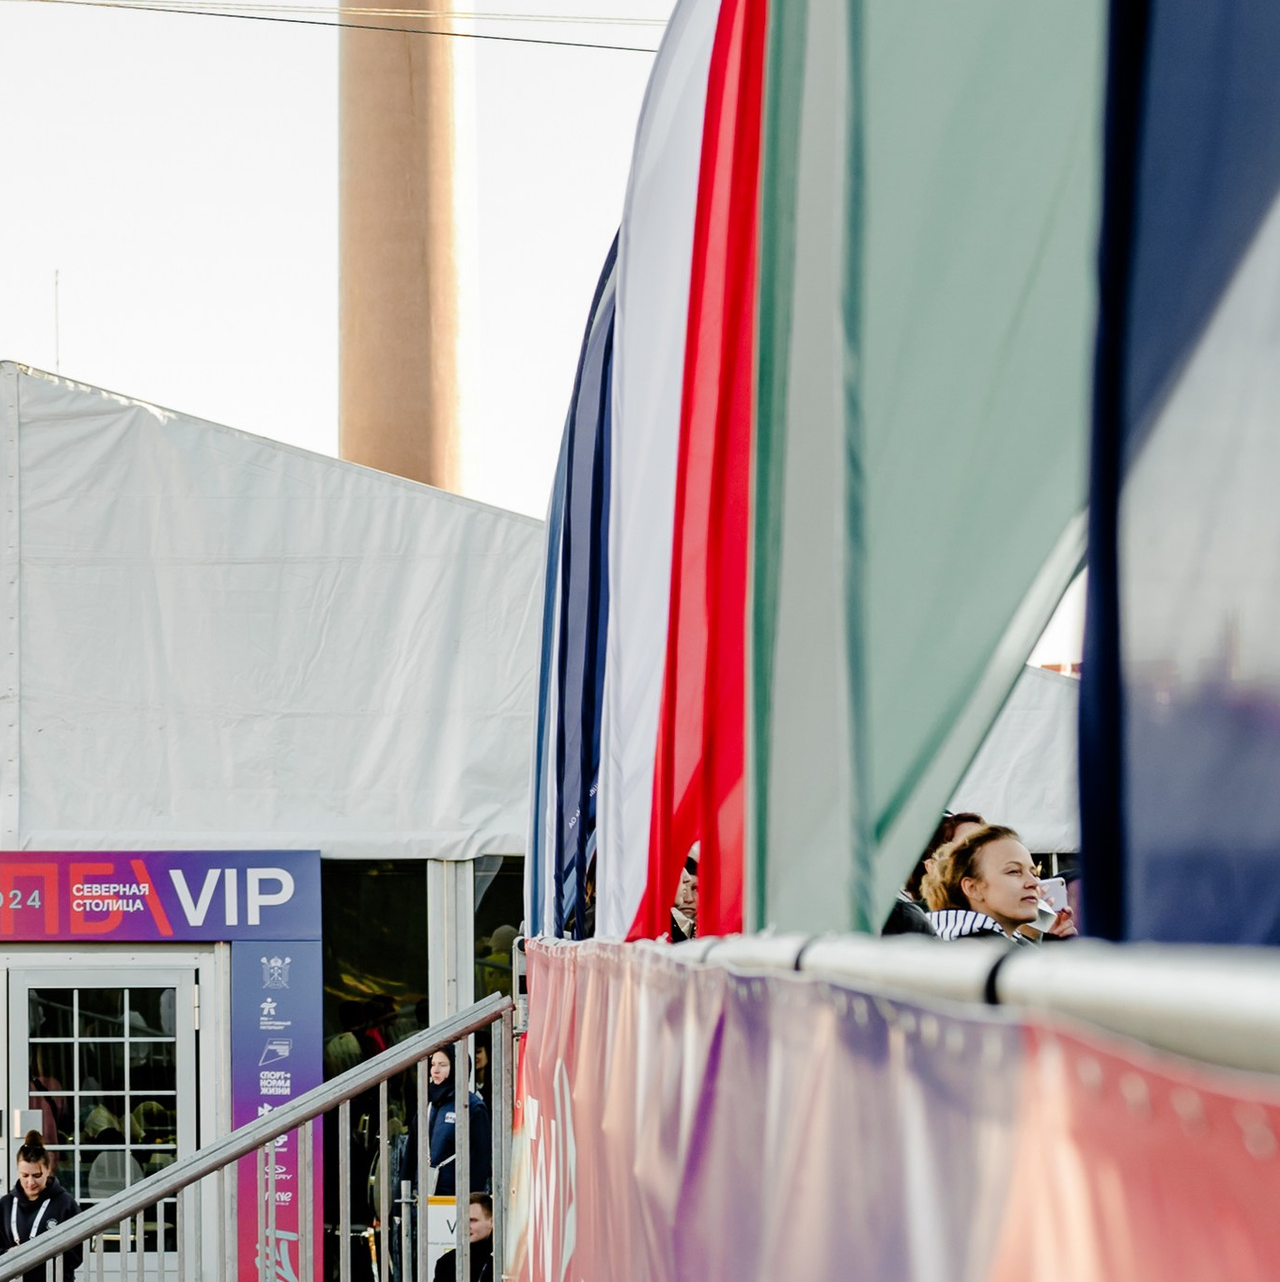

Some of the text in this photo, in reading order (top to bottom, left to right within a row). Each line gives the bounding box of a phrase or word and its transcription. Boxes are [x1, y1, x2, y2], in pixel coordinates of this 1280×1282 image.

[72, 883, 149, 896] СЕВЕРНАЯ
[169, 867, 295, 927] VIP
[72, 899, 144, 912] СТОЛИЦА
